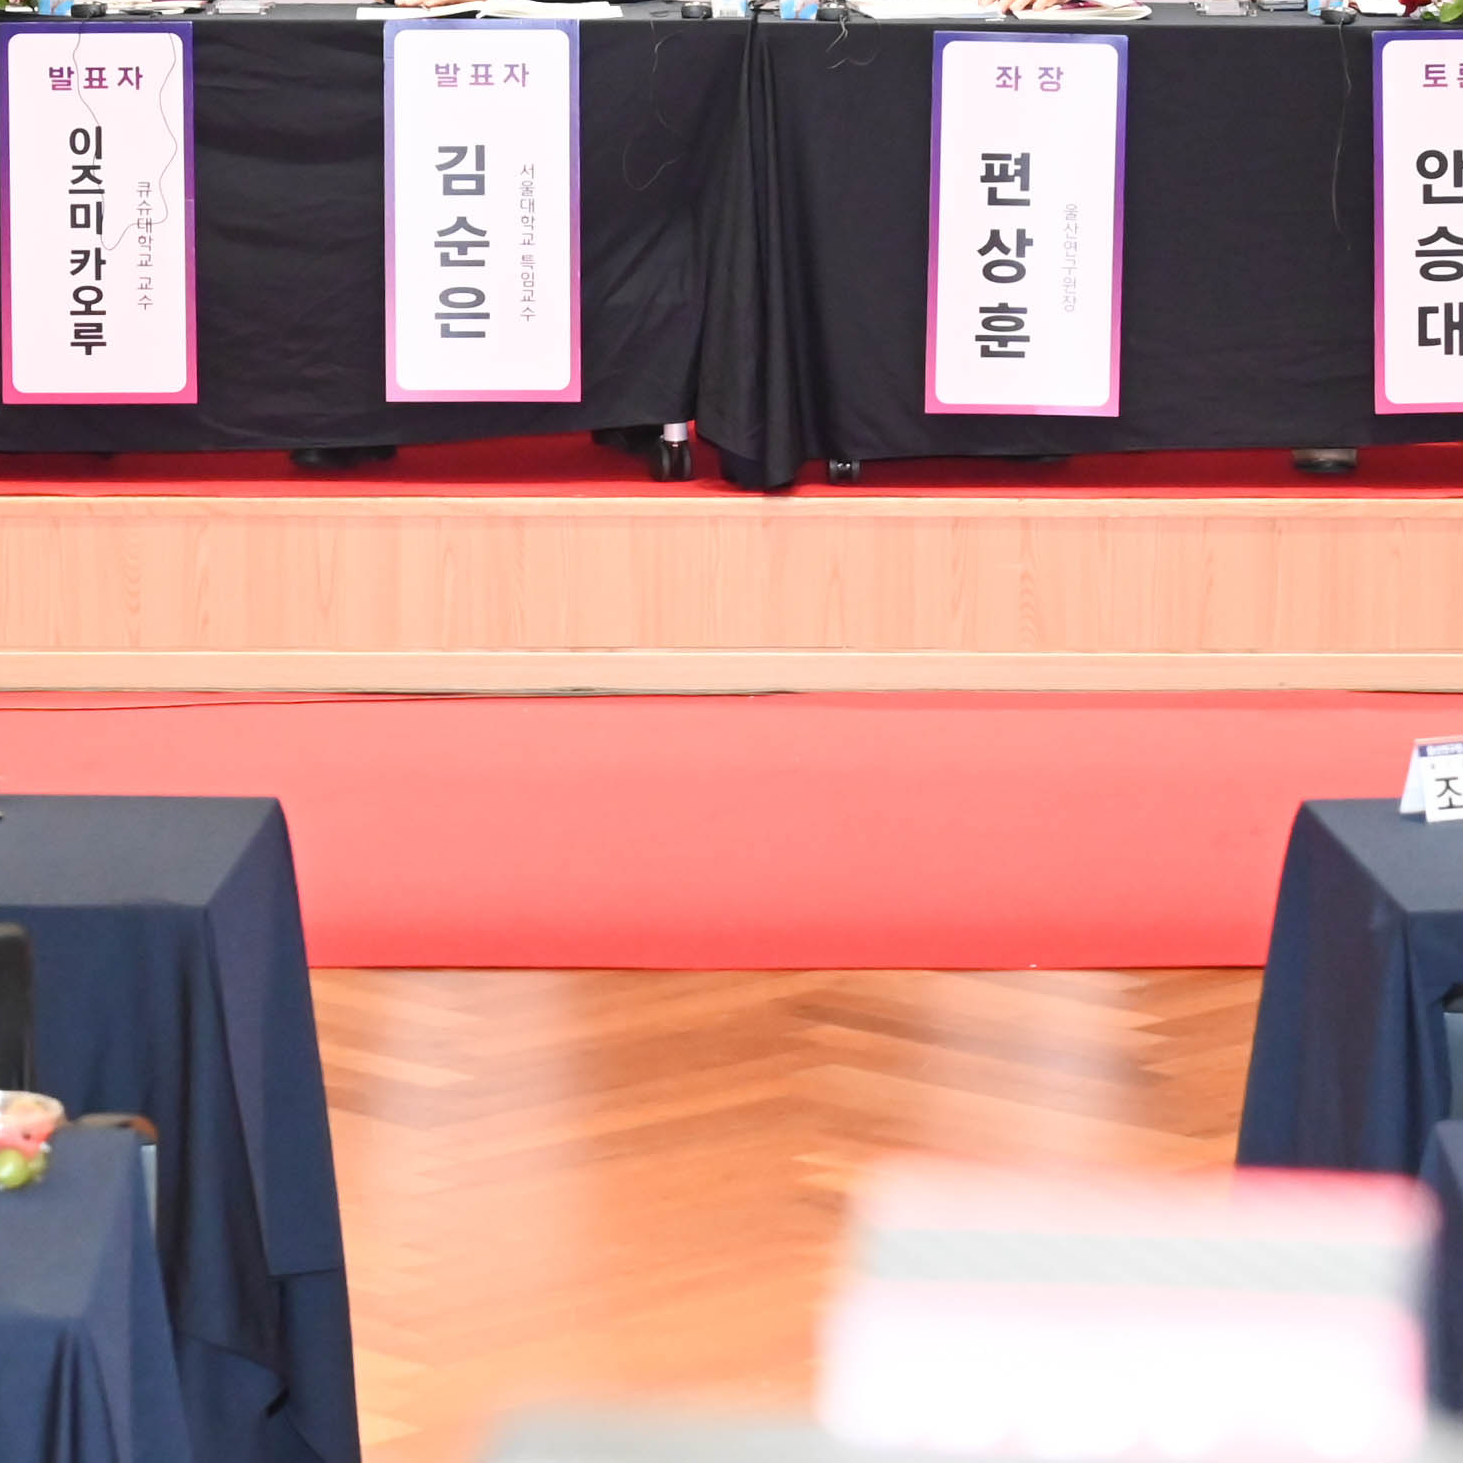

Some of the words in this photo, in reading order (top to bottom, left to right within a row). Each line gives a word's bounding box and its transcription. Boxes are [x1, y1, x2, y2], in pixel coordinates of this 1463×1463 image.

[49, 66, 143, 90] 발표자
[435, 63, 529, 87] 발표자
[996, 66, 1063, 92] 좌장
[69, 126, 105, 236] 이즈미
[520, 164, 535, 246] 서울대학교
[434, 145, 490, 338] 김순은
[975, 153, 1033, 358] 편상훈
[70, 248, 106, 355] 카오루
[138, 277, 153, 310] 교수
[521, 255, 535, 321] 특임교수
